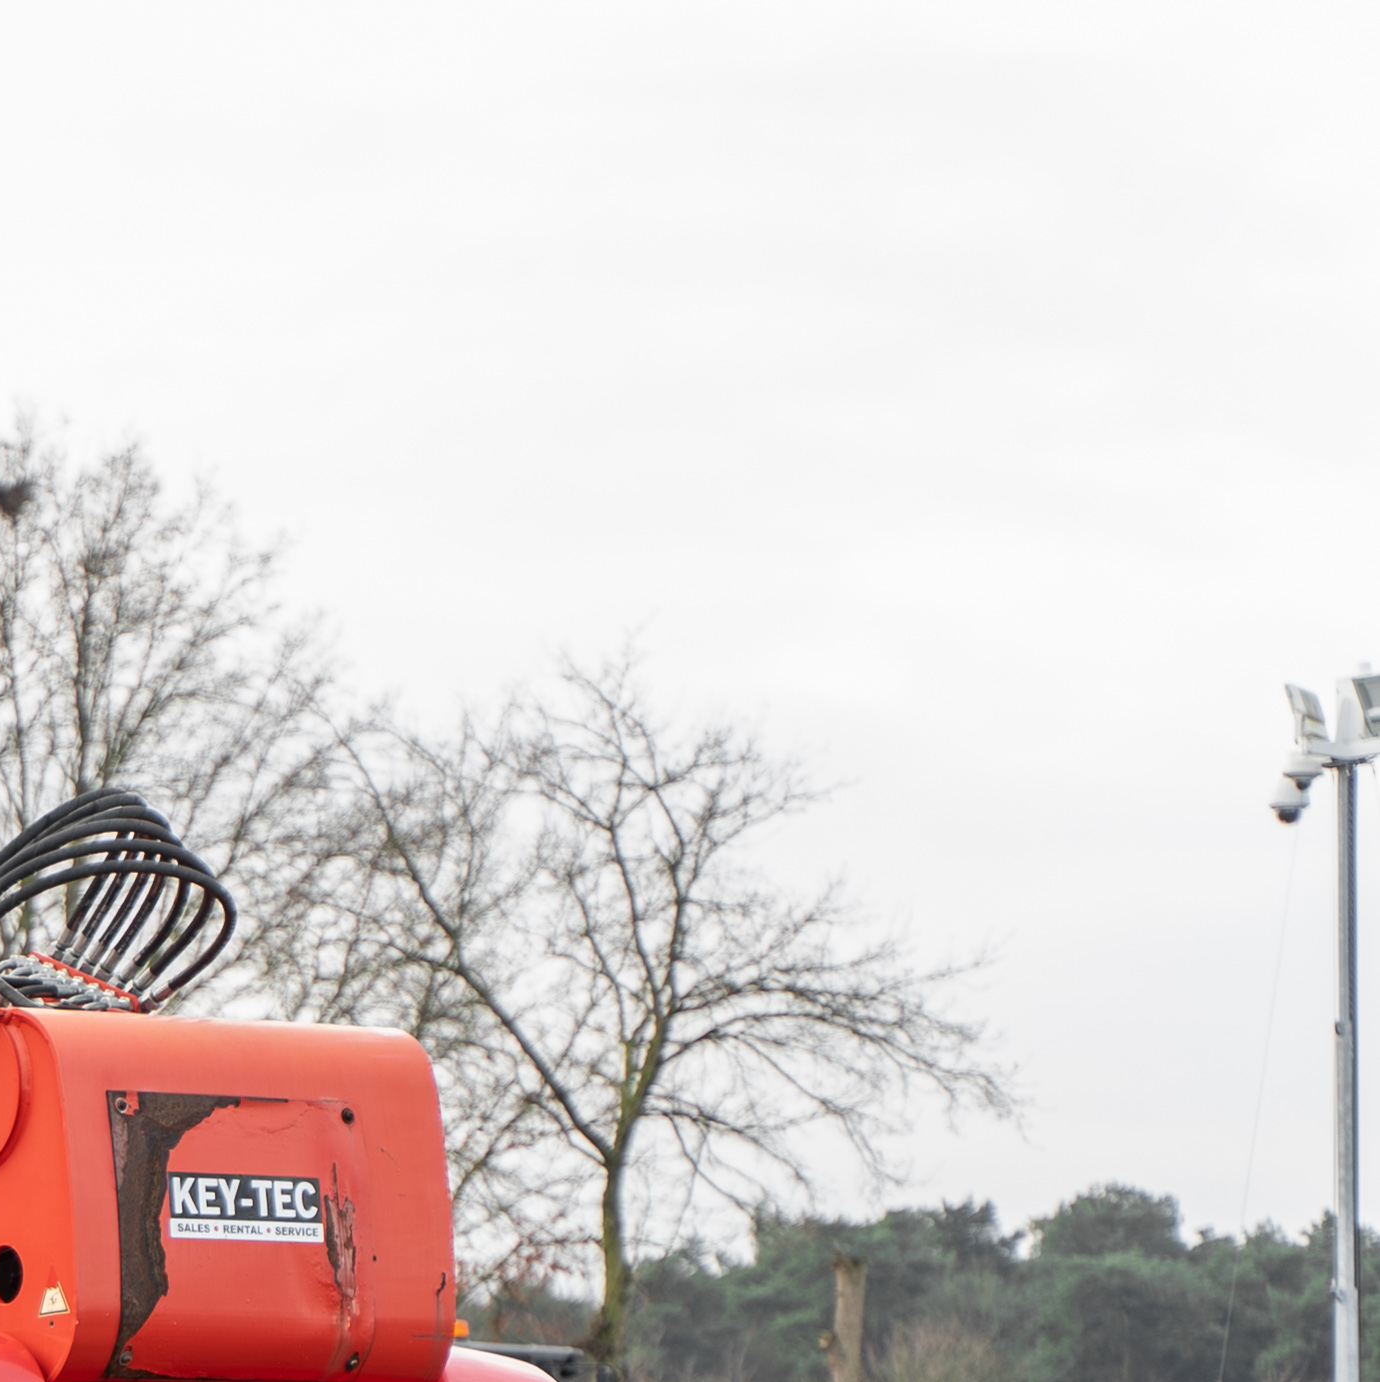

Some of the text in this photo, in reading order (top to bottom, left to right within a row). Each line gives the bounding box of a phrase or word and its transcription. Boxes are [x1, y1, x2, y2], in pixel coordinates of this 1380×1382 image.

[171, 1176, 319, 1219] KEY-TEC
[177, 1222, 319, 1238] SALES RENTAL SERVICE
